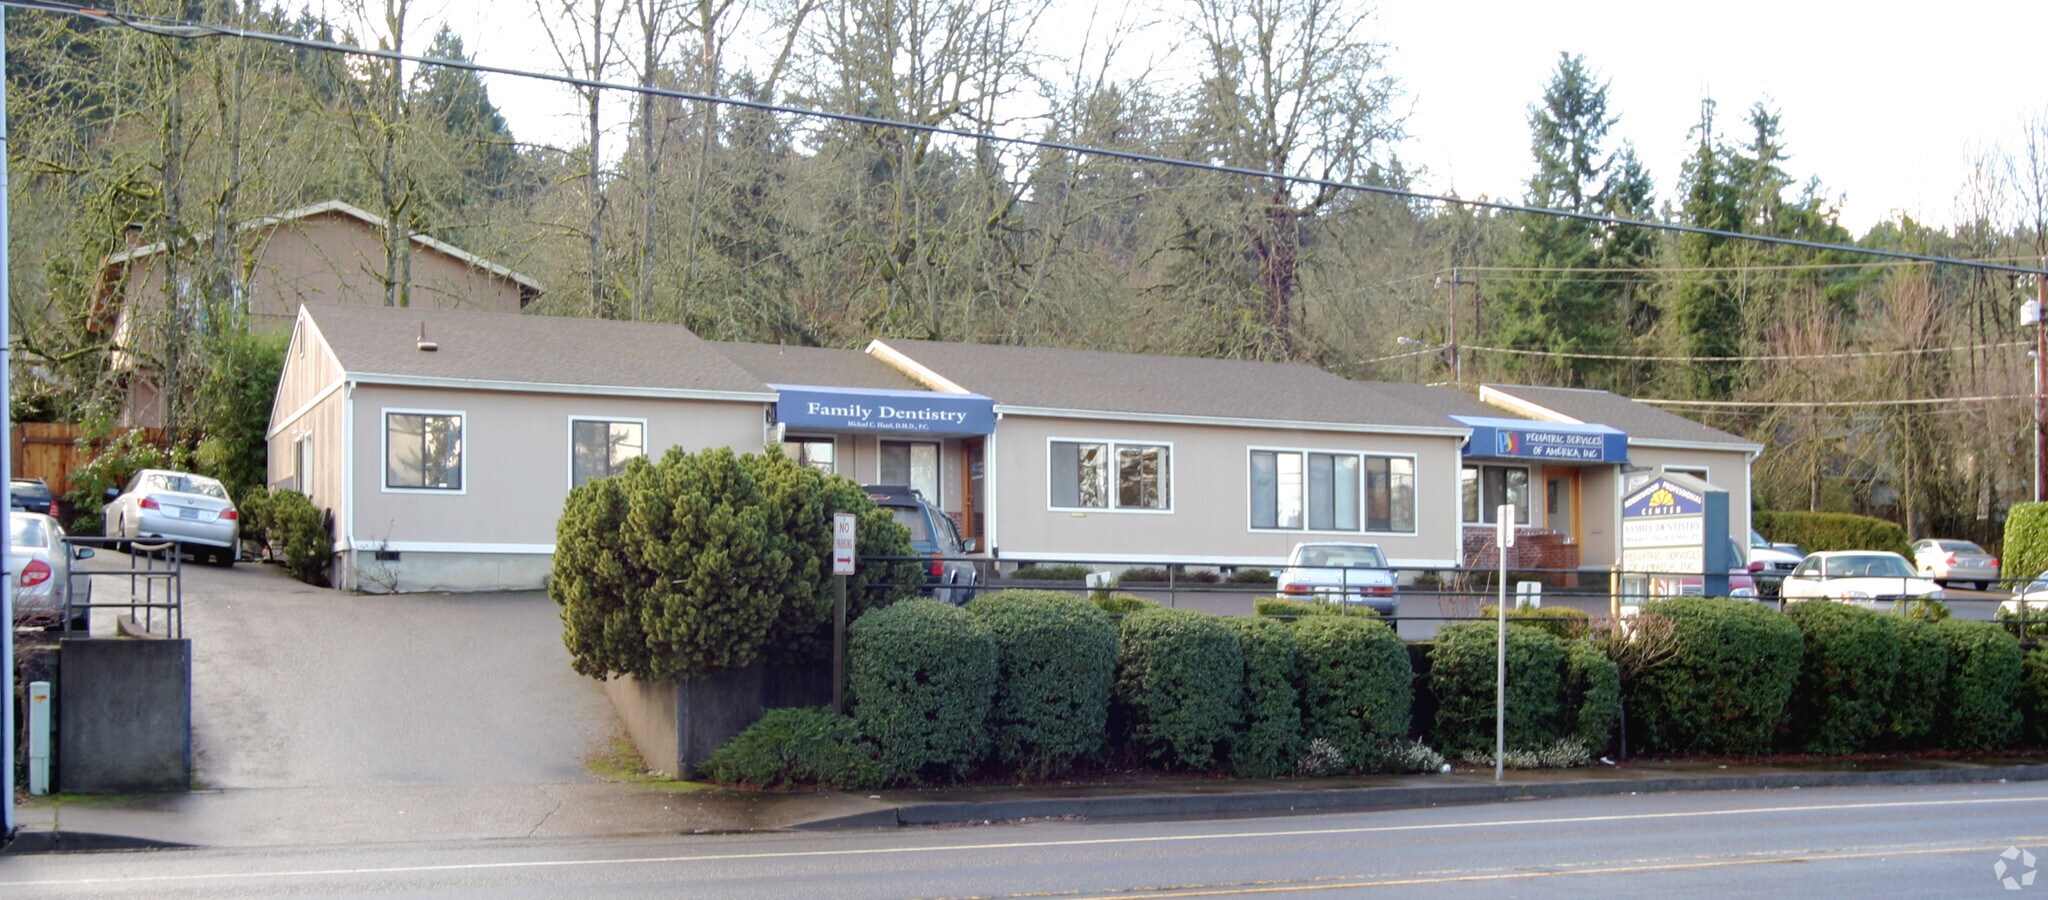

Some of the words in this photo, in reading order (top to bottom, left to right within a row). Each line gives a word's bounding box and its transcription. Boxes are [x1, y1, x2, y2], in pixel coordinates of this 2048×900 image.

[807, 402, 872, 420] Family
[879, 405, 967, 424] Dentistry
[1526, 432, 1565, 444] PEDIATRIC
[1566, 434, 1602, 446] SERVICES
[1533, 446, 1543, 455] OF
[1641, 506, 1681, 515] CENTER
[840, 522, 850, 533] NO
[1626, 524, 1652, 533] FAMILY
